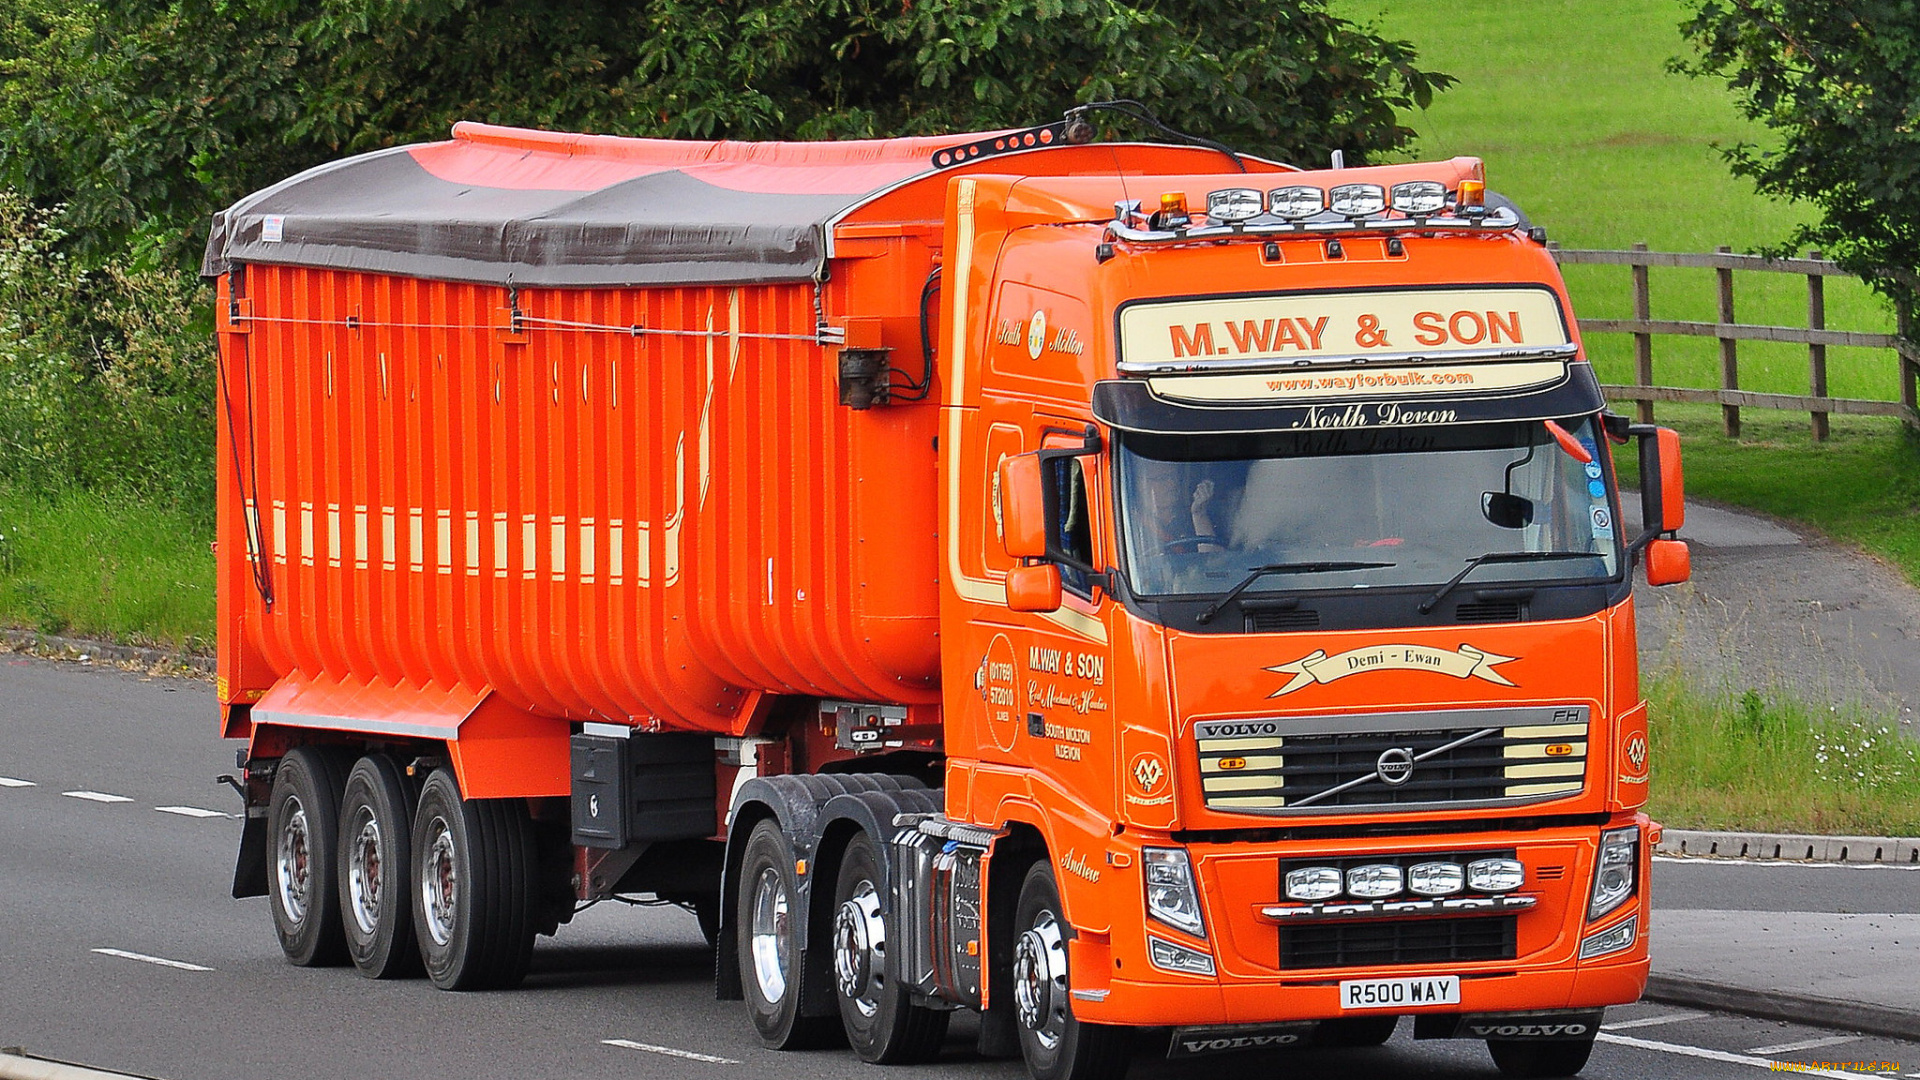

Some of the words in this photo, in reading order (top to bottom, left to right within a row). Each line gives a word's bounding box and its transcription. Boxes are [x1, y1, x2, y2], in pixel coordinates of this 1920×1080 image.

[1169, 316, 1329, 358] M.WAY
[1355, 313, 1393, 347] &
[1414, 310, 1523, 346] SON
[1266, 370, 1473, 392] www.wayforbulk.com
[1291, 405, 1369, 428] North
[1376, 402, 1457, 425] Devon
[1029, 646, 1061, 673] M.WAY
[1065, 652, 1073, 676] &
[1077, 653, 1103, 679] SON
[1347, 650, 1384, 669] Demi
[1404, 649, 1441, 666] Ewan
[1551, 709, 1582, 722] FH
[1203, 723, 1277, 736] VOLVO
[1061, 847, 1100, 883] Andrew
[1350, 984, 1404, 1004] R500
[1410, 980, 1450, 1002] WAY
[1470, 1024, 1587, 1036] VOLVO
[1183, 1035, 1298, 1052] VOLVO
